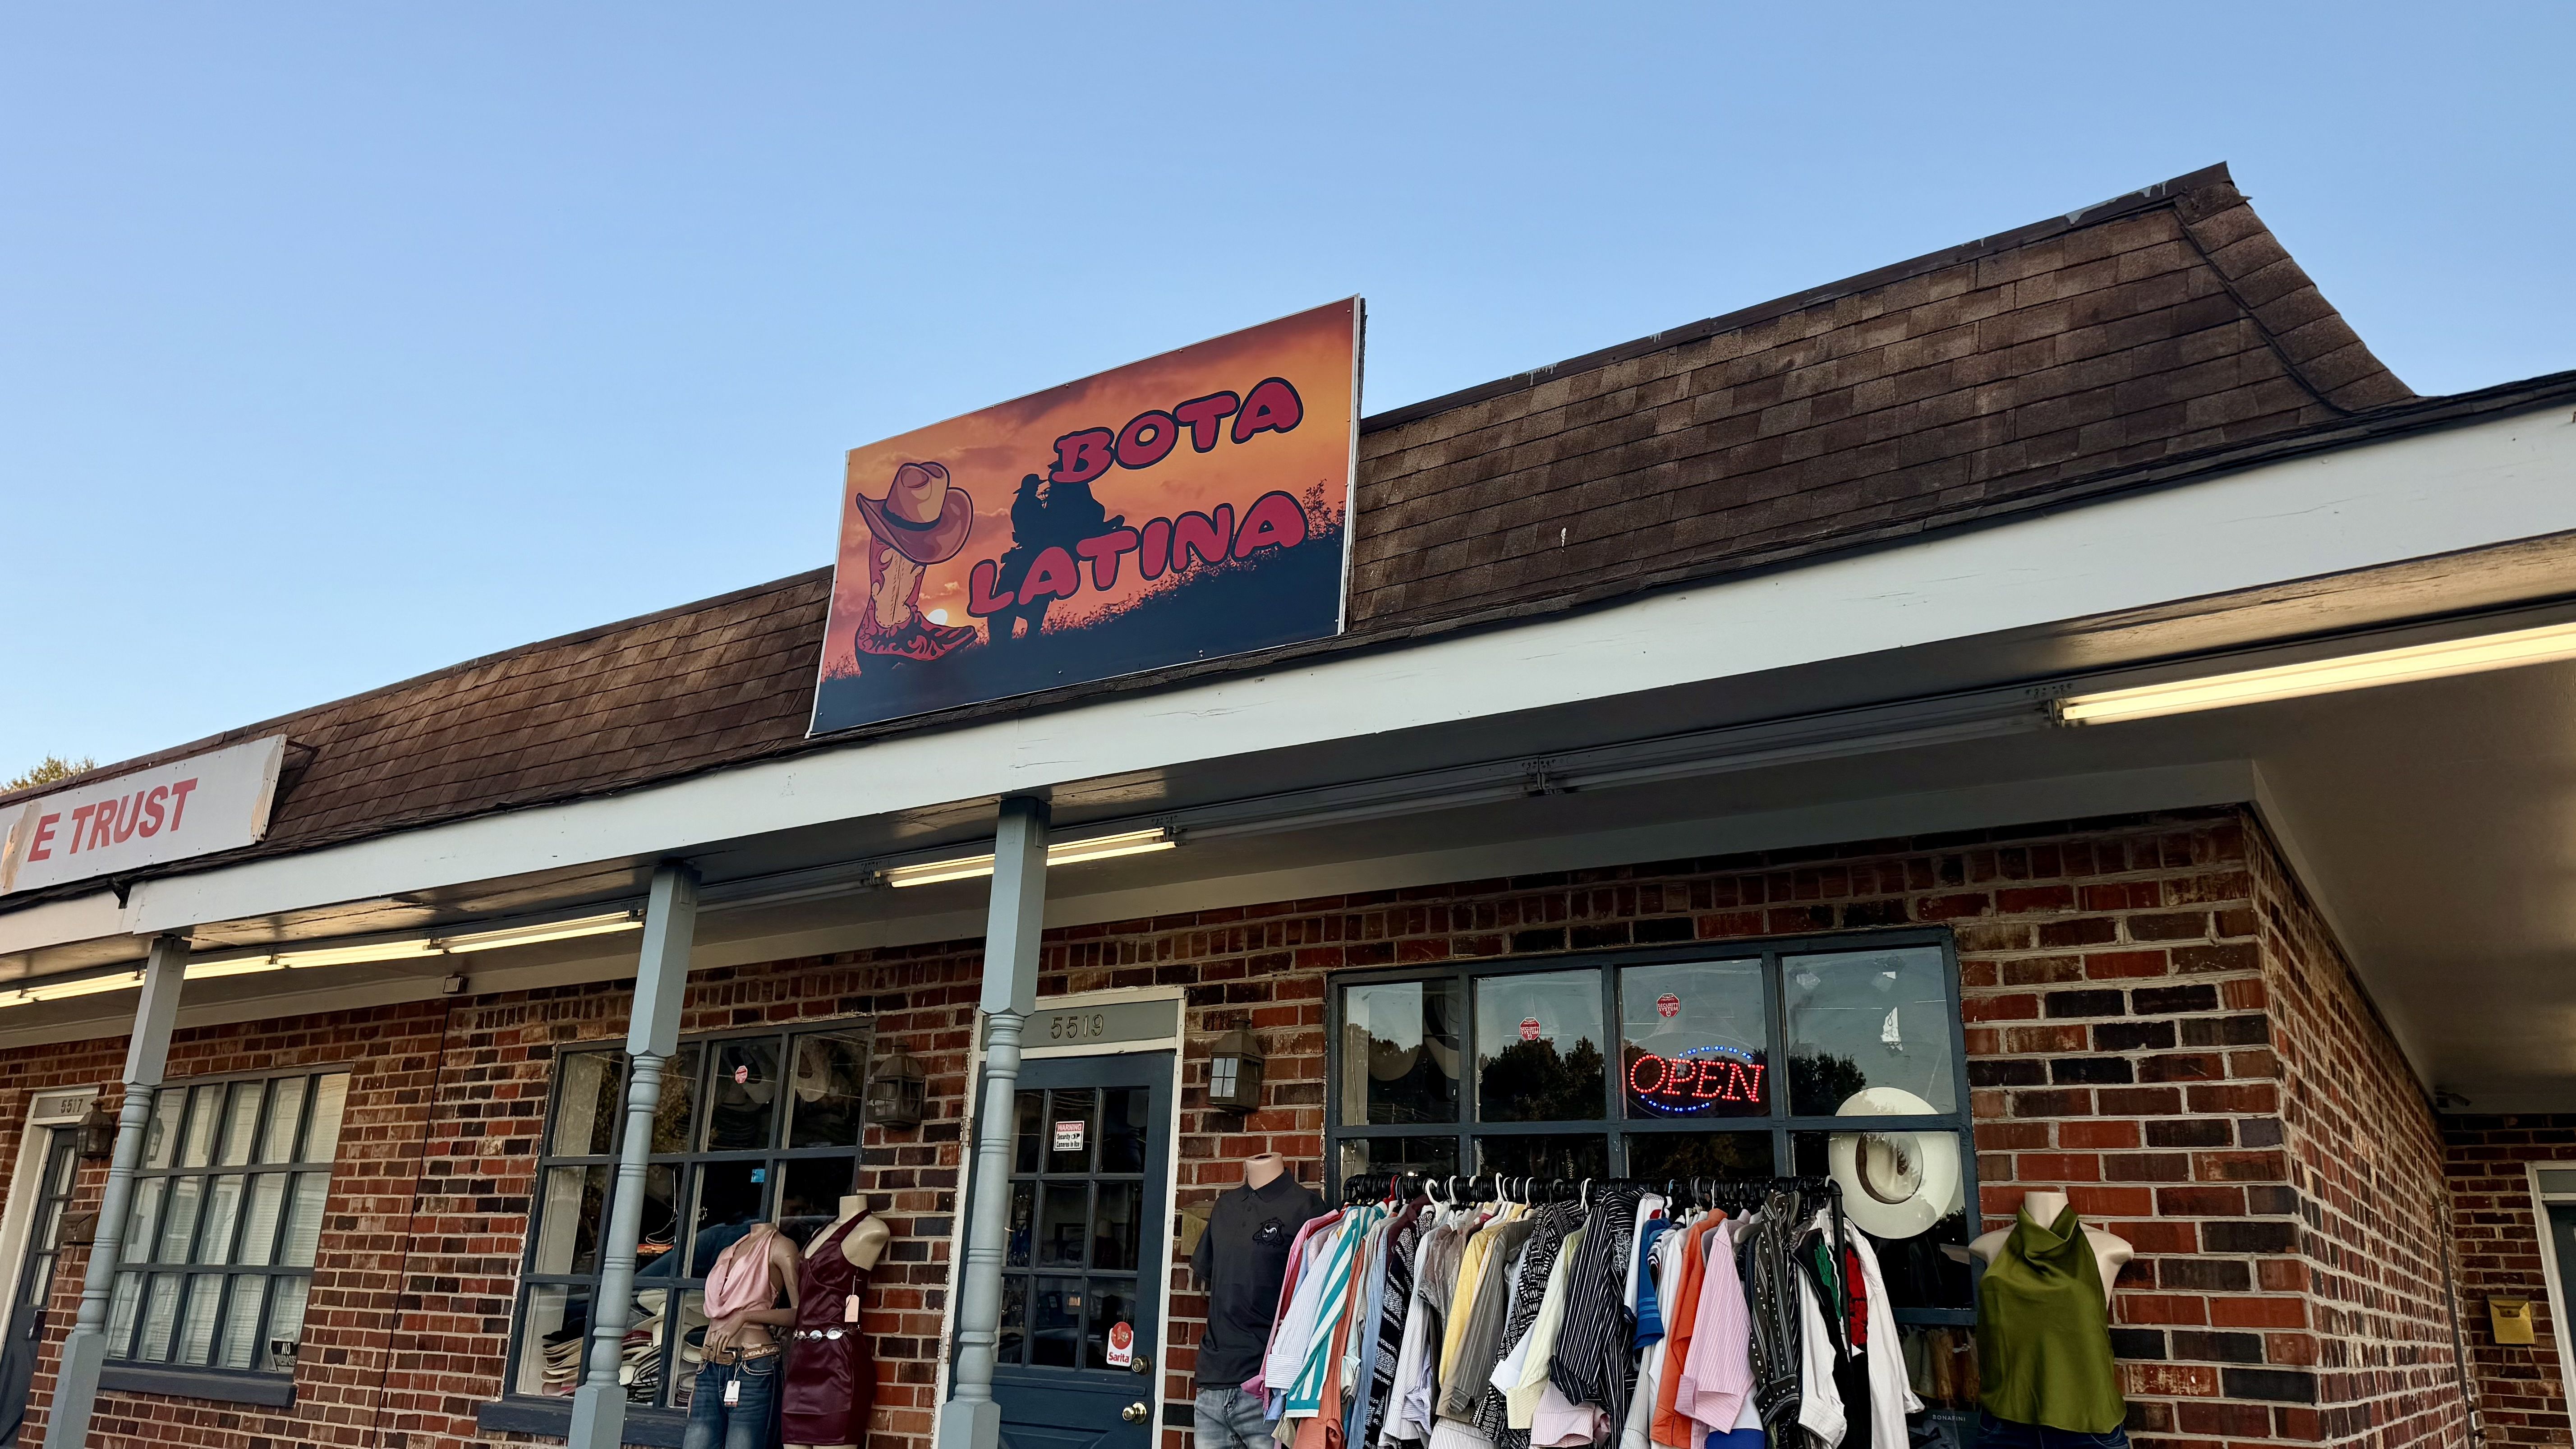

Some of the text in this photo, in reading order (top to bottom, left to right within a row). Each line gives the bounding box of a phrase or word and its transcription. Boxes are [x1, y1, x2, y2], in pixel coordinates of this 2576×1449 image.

[1049, 377, 1303, 483] BOTA
[967, 491, 1308, 617] LATINA
[28, 777, 198, 862] E TRUST
[1050, 1014, 1104, 1039] 5519
[1629, 1054, 1765, 1103] OPEN
[60, 1098, 83, 1113] 5517
[1108, 1352, 1129, 1363] Sarita
